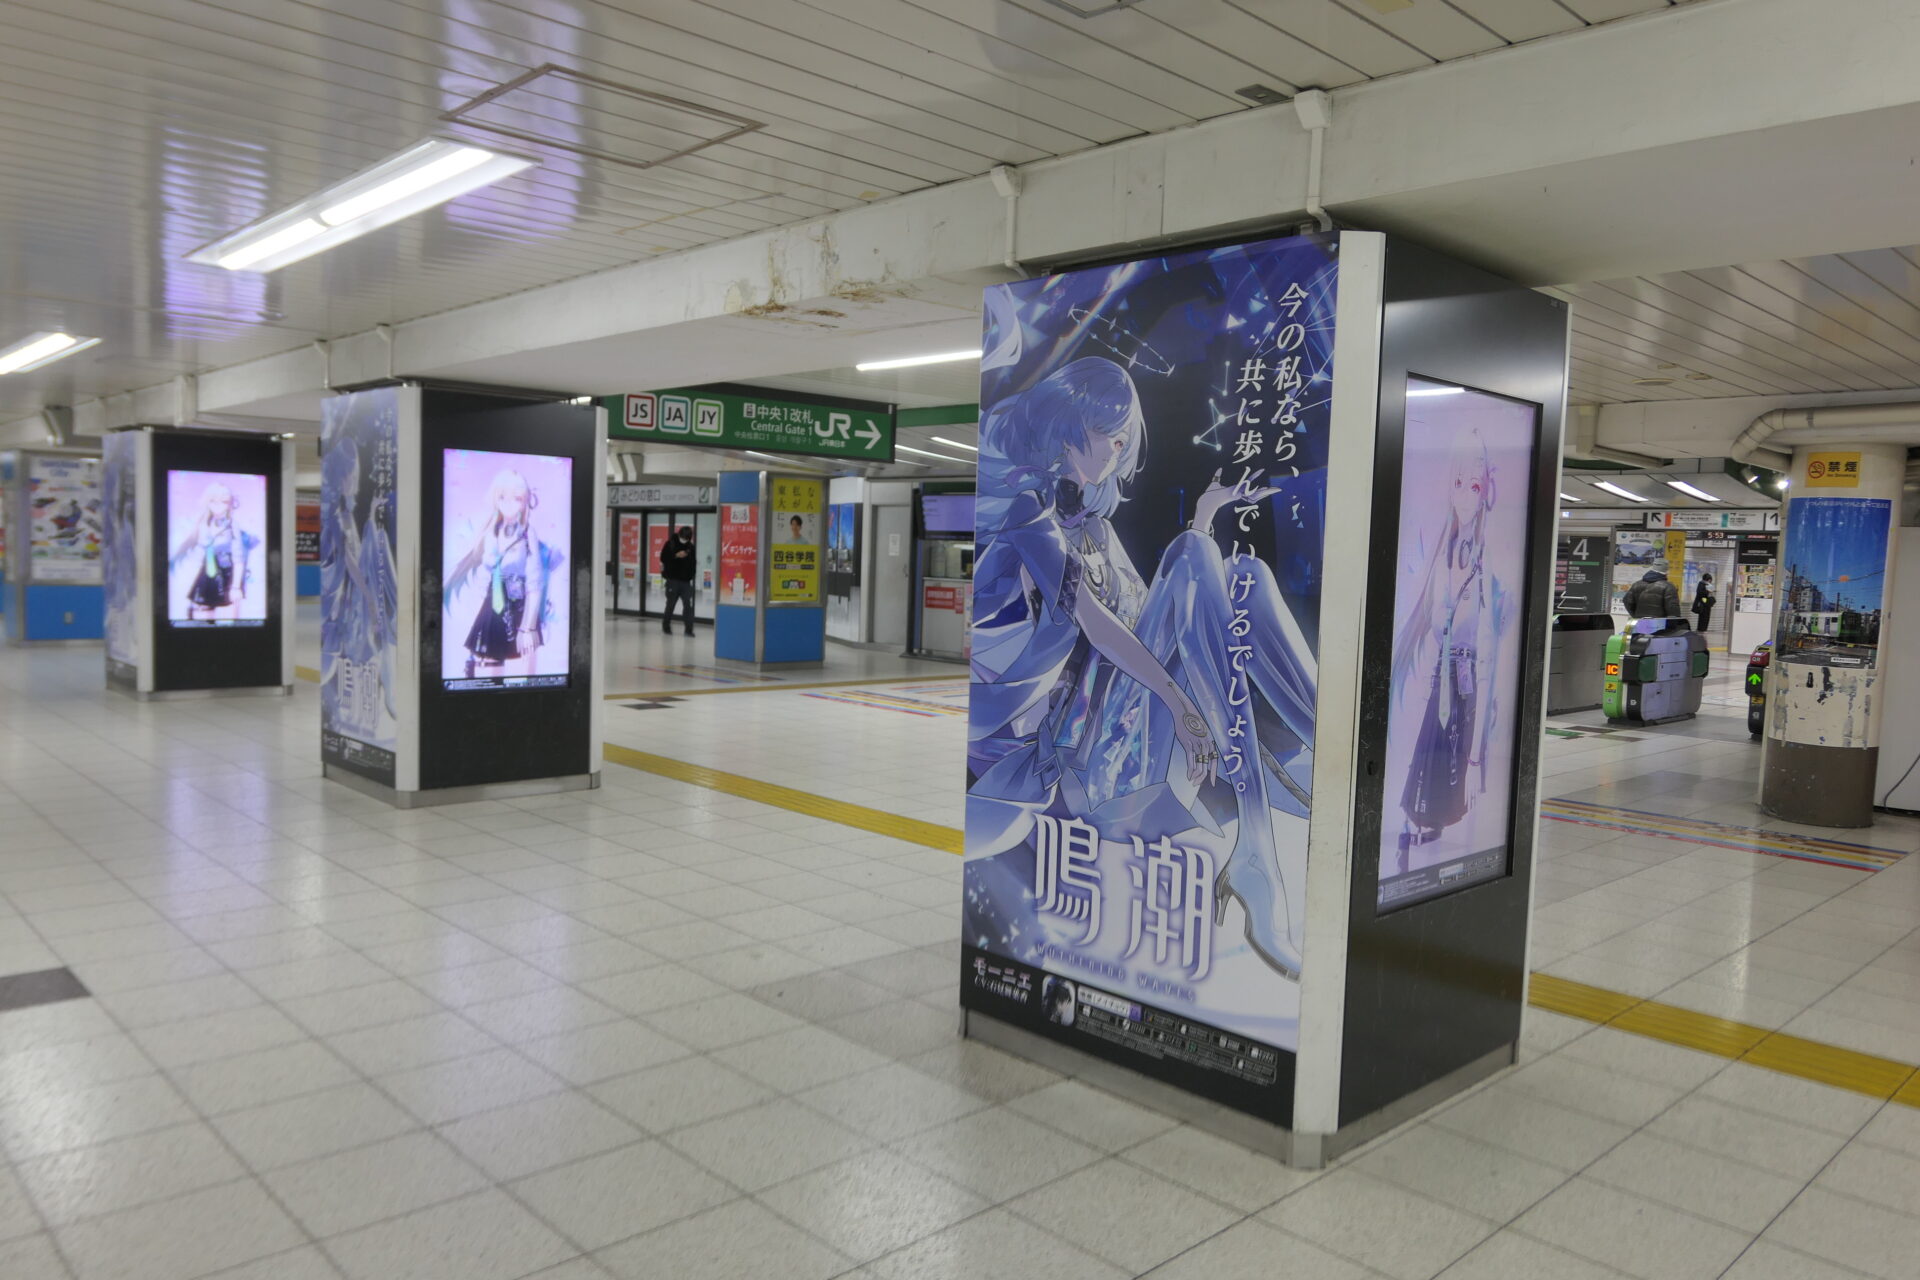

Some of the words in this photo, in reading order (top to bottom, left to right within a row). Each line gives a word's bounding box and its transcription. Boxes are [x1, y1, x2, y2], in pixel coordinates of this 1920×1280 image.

[1273, 282, 1309, 478] 今の私なら、
[632, 403, 648, 418] JS
[665, 406, 684, 422] JA
[700, 410, 717, 425] JY
[757, 405, 813, 424] 中央1改札
[751, 420, 783, 433] Central
[785, 424, 806, 436] Gate
[814, 412, 851, 440] JR
[1828, 461, 1857, 472] 禁煙
[1572, 538, 1590, 561] 4
[1223, 358, 1267, 793] 共に歩んでいけるでしょう。
[1607, 664, 1619, 675] IC
[1033, 812, 1215, 982] 鳴潮
